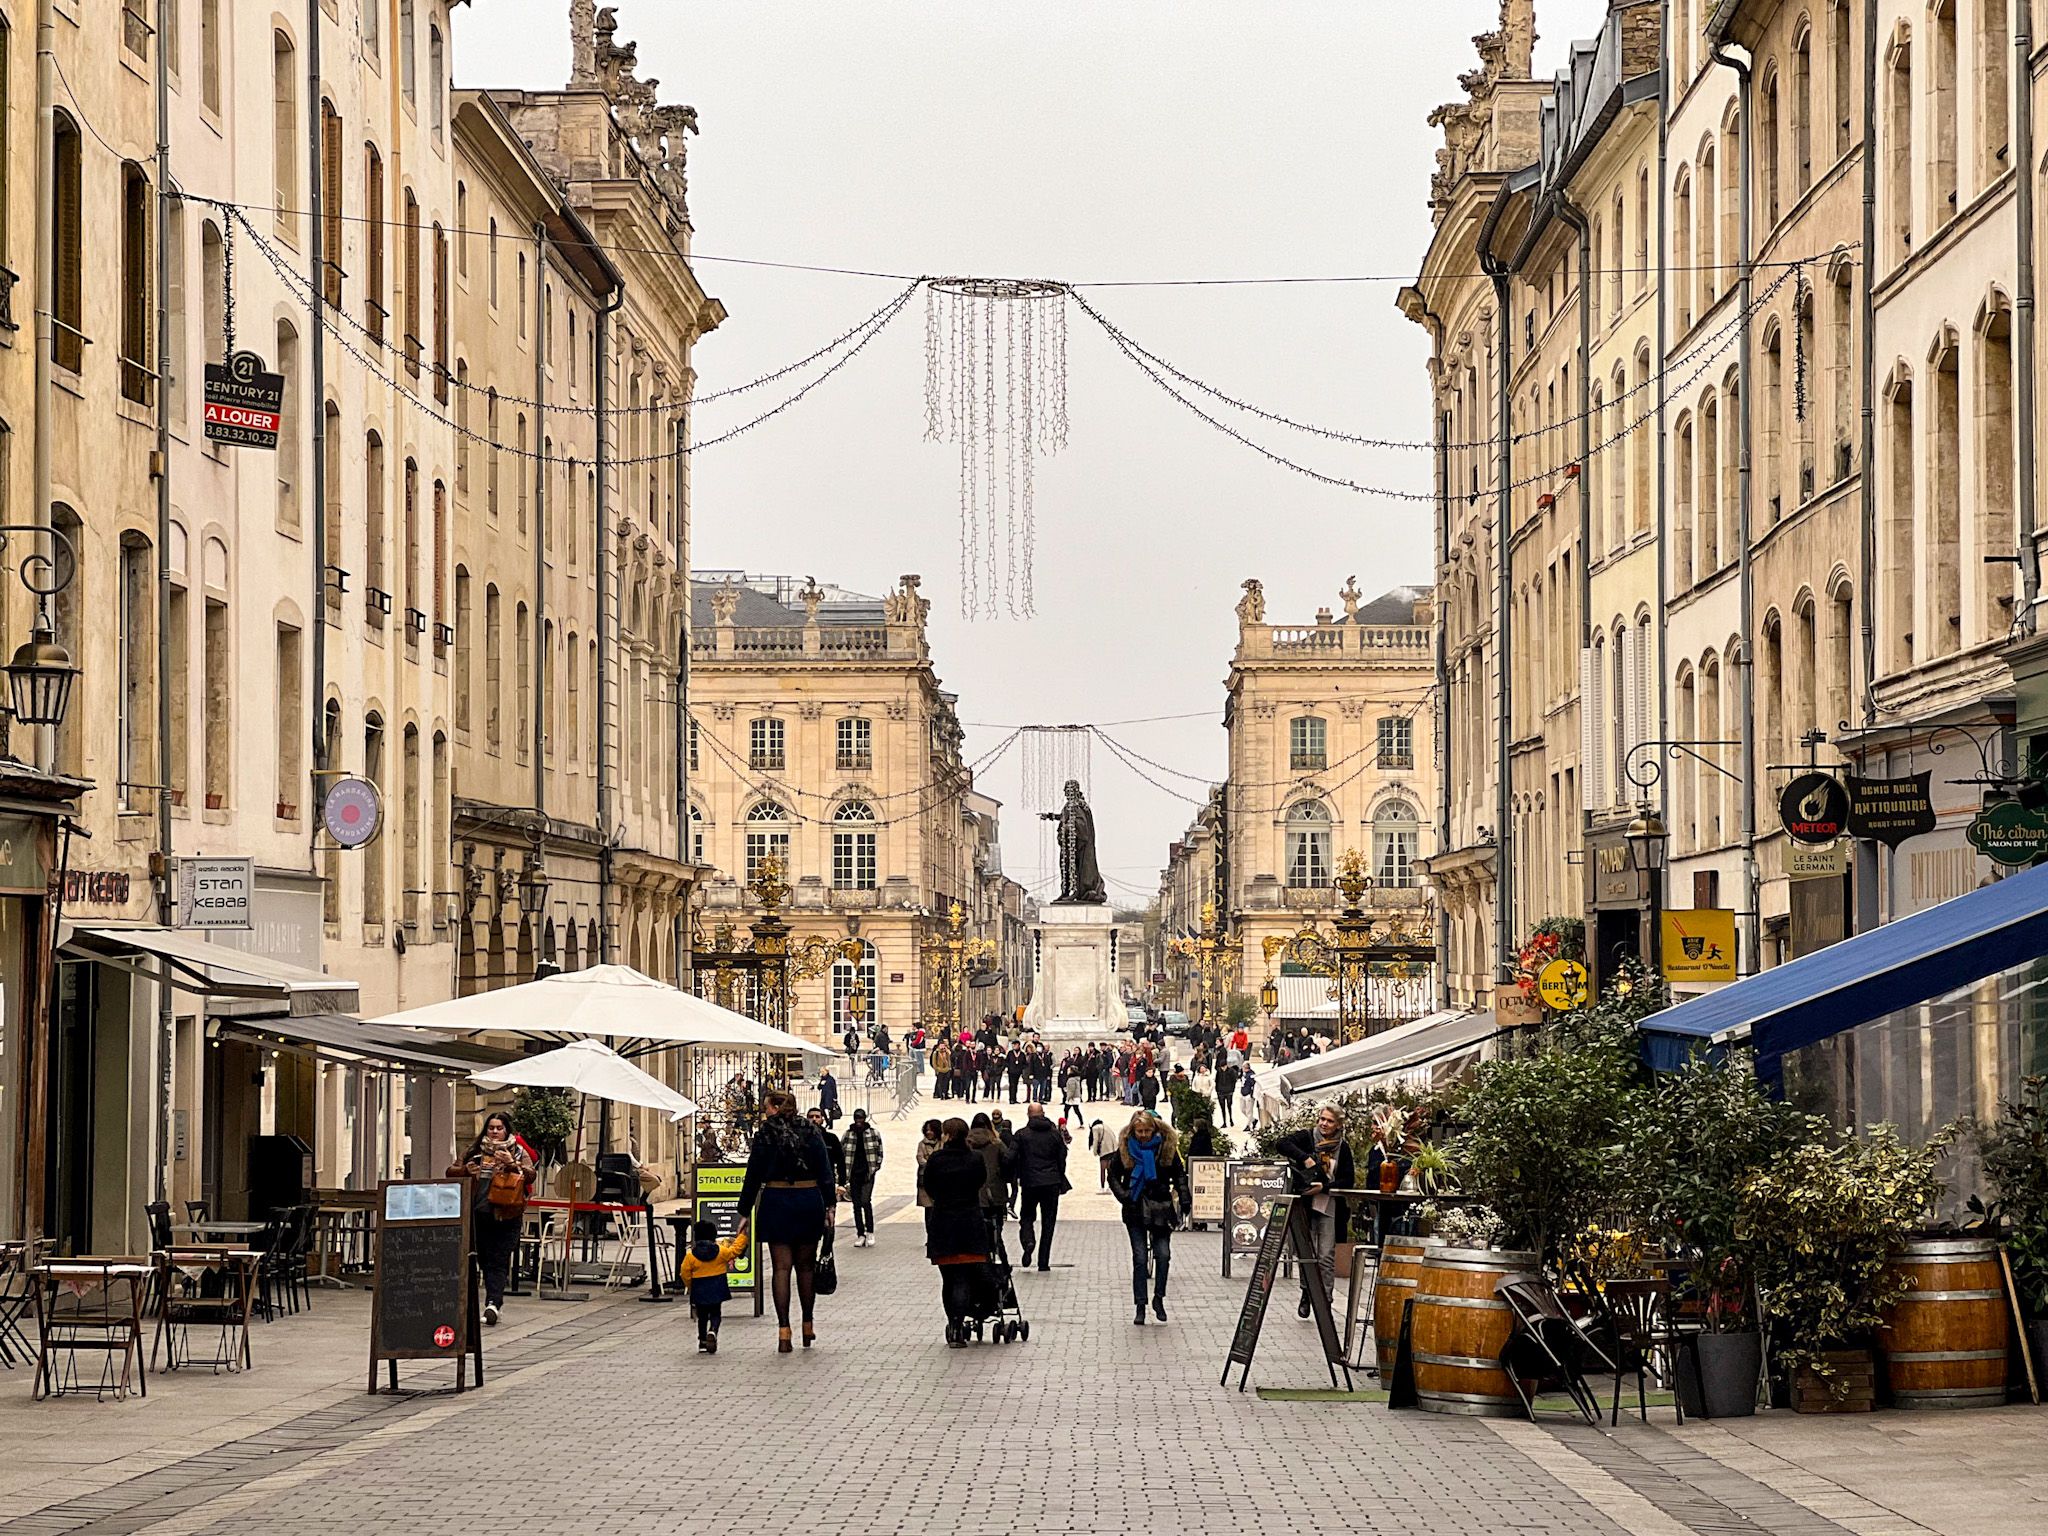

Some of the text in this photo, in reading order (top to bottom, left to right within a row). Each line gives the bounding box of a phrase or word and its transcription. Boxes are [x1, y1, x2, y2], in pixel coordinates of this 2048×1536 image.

[238, 361, 254, 376] 21
[205, 381, 279, 402] CENTURY 21
[205, 406, 272, 429] A LOUER
[1854, 799, 1928, 816] ANTIQUAIRE
[1791, 822, 1838, 834] METEOR
[1977, 823, 2048, 841] Thé citron
[2025, 839, 2039, 848] THÉ
[1793, 855, 1834, 863] LE SAINT
[1793, 863, 1835, 871] GERMAIN
